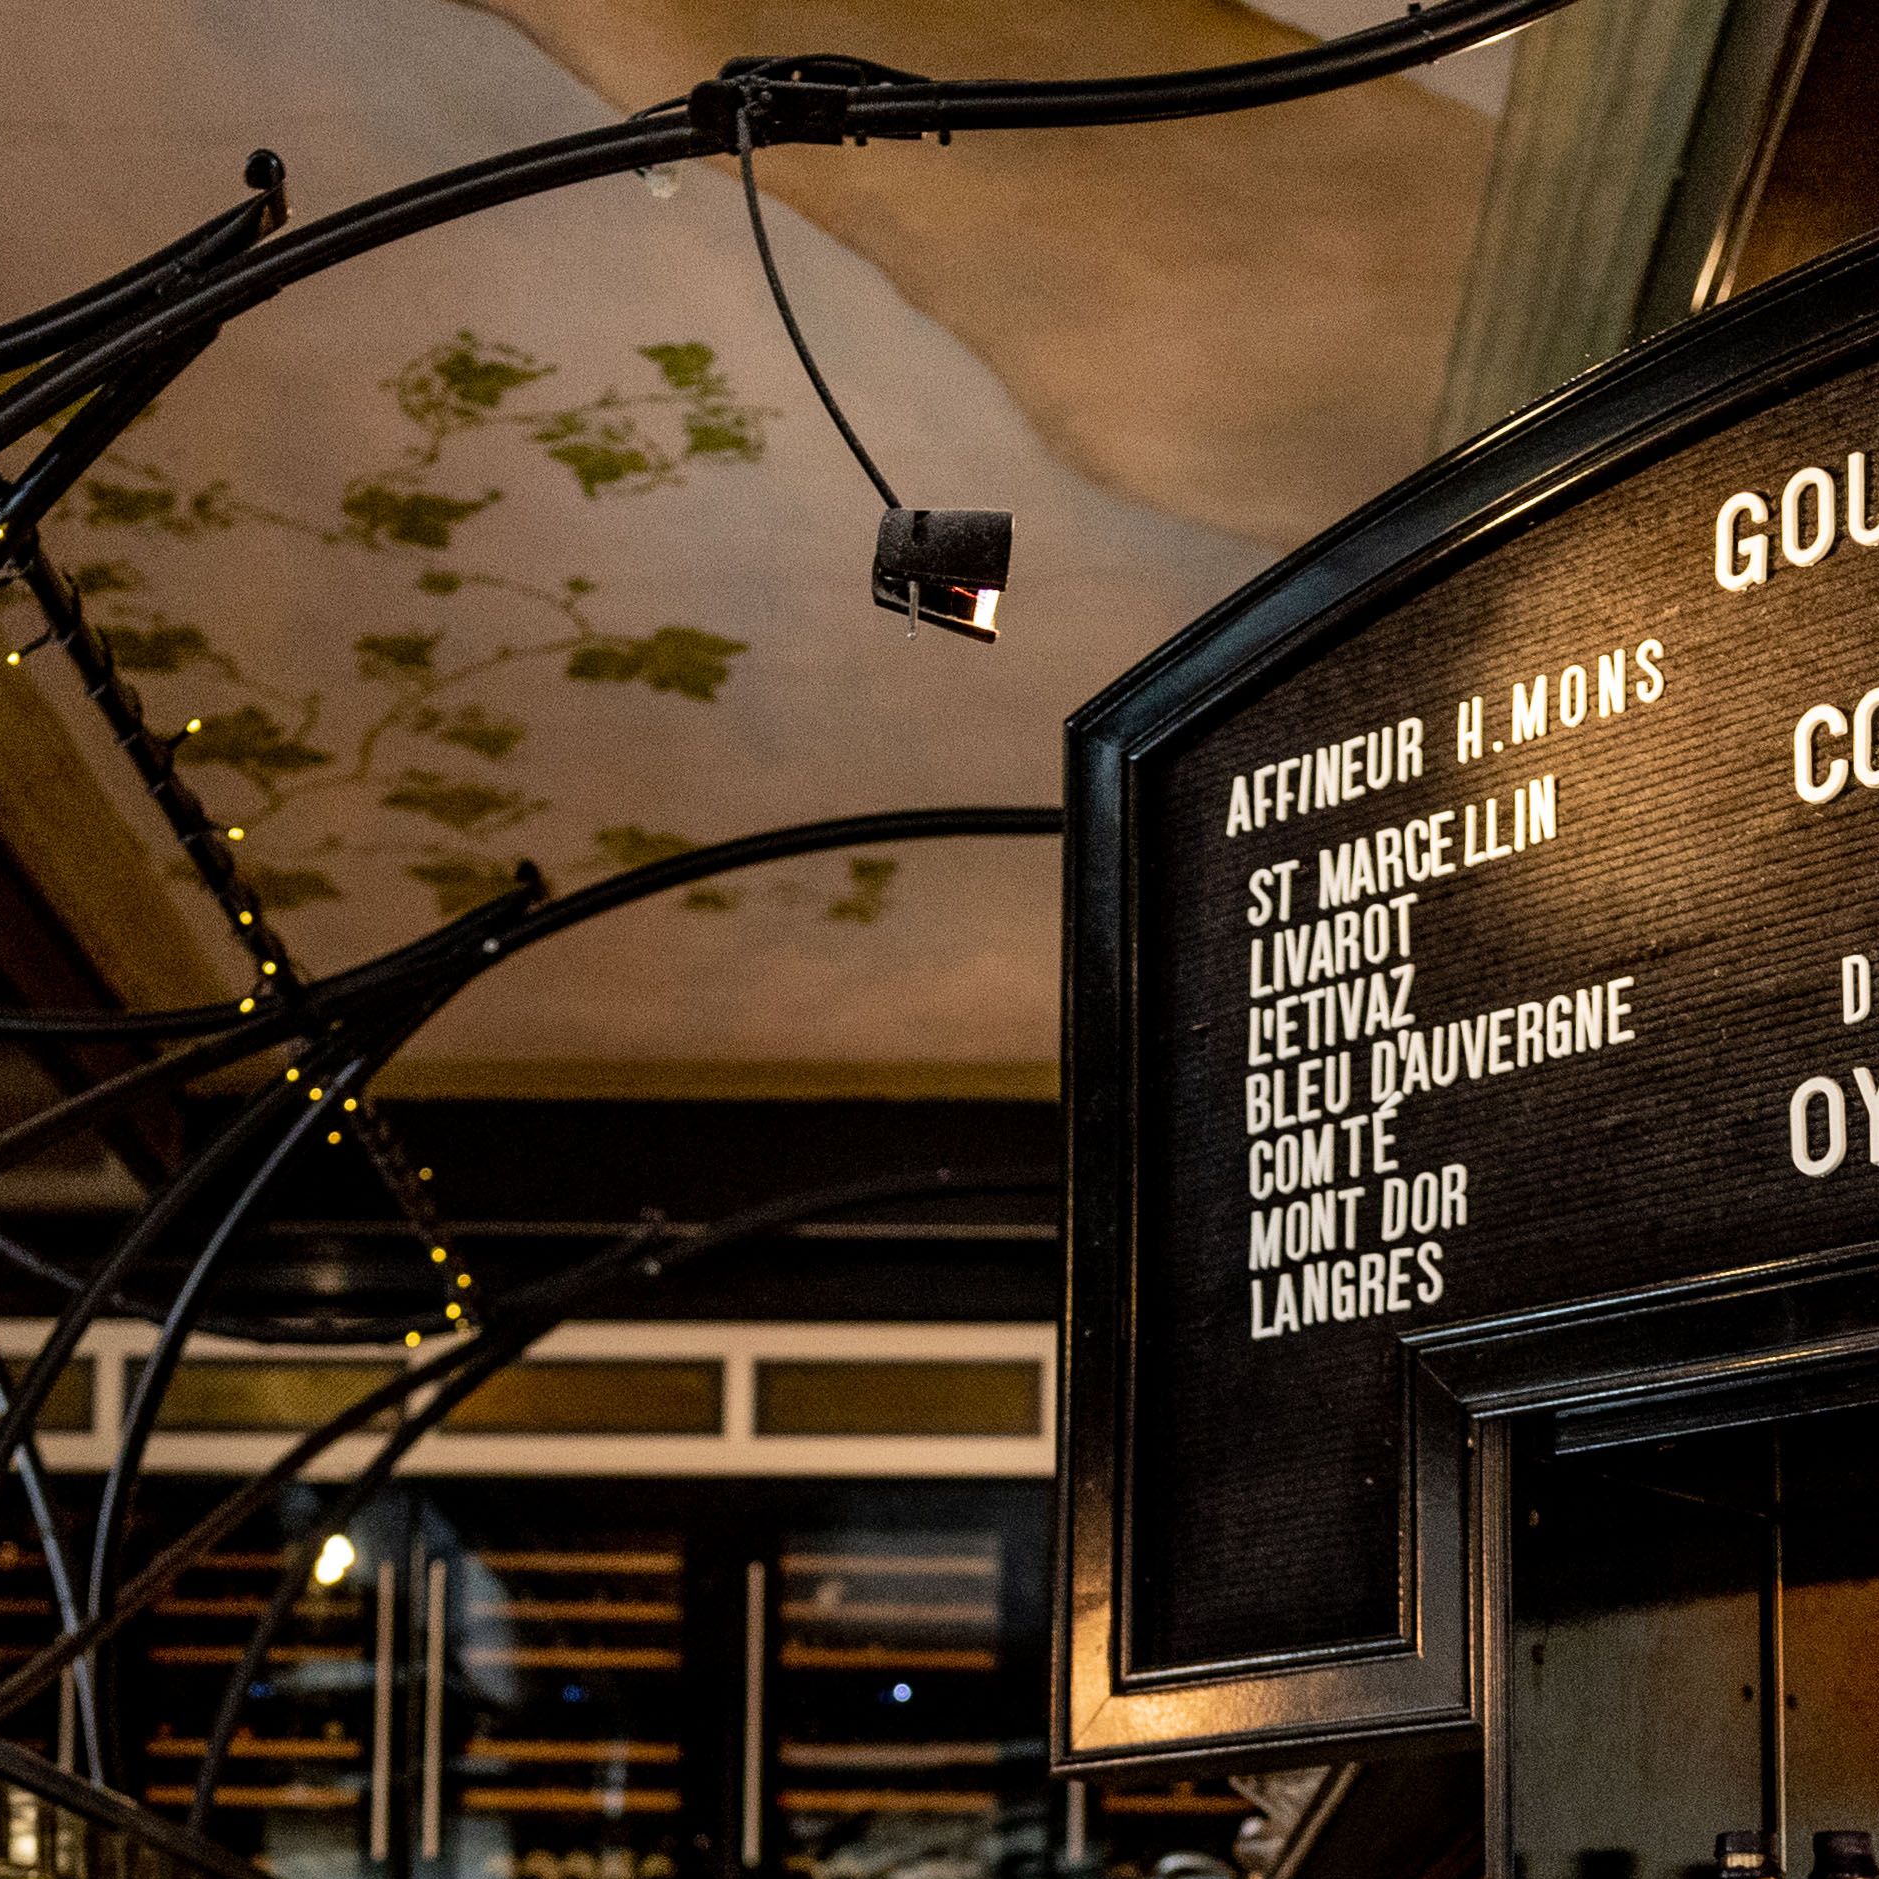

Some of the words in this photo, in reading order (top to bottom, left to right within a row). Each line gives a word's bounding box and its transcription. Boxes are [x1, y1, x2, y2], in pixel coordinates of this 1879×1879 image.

[1225, 716, 1425, 838] AFFINEUR
[1247, 859, 1299, 927] ST
[1319, 772, 1558, 910] MARCELLIN
[1249, 892, 1420, 999] LIVAROT
[1245, 1051, 1351, 1136] BLEU
[1370, 975, 1637, 1104] D'AUVERGNE
[1248, 962, 1418, 1066] L'ETIVAZ
[1249, 1090, 1403, 1202] COMTÉ
[1248, 1186, 1366, 1271] MONT
[1381, 1163, 1468, 1242] DOR
[1252, 1240, 1445, 1339] LANGRES
